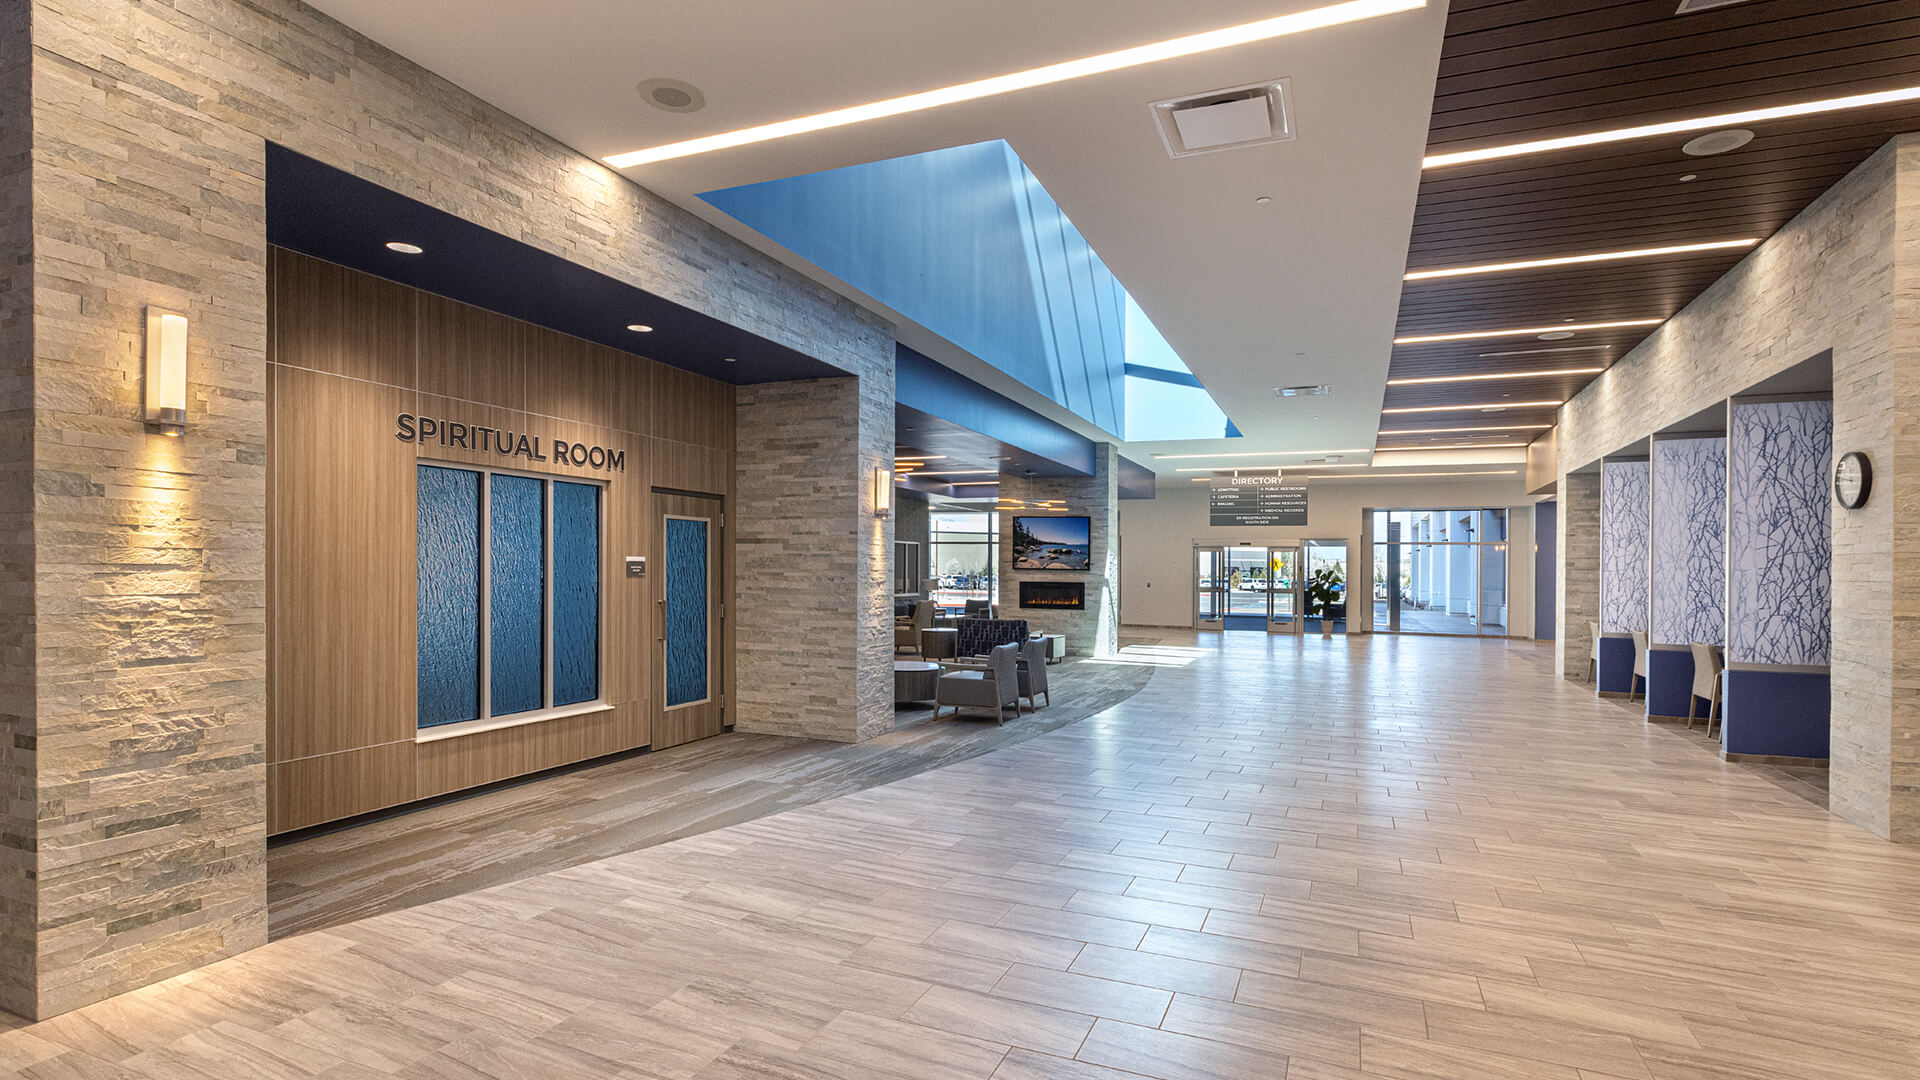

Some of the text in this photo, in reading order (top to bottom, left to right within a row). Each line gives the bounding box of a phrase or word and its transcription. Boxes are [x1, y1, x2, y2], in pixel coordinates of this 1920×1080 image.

[396, 412, 626, 472] SPIRITUAL ROOM
[1231, 477, 1283, 485] DIRECTORY
